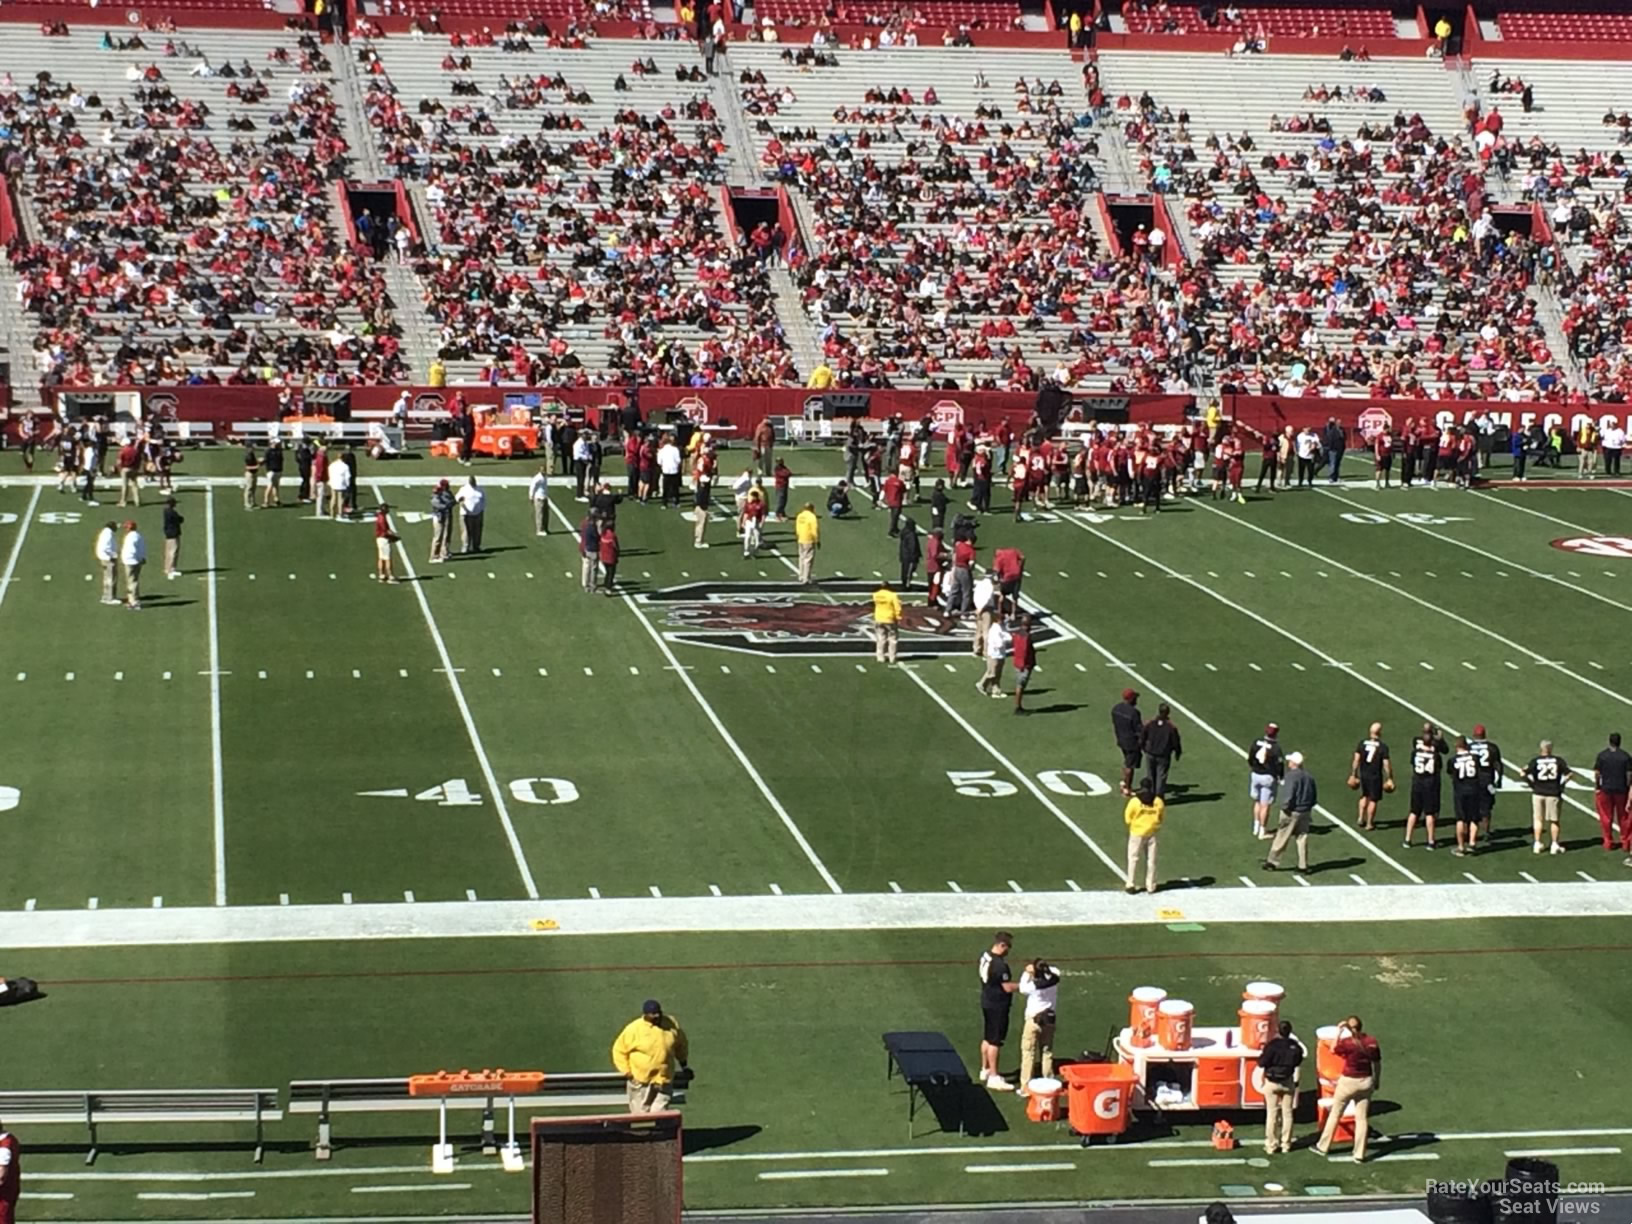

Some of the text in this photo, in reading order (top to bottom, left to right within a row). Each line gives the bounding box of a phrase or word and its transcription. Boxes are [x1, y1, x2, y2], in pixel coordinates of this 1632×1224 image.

[1364, 745, 1377, 763] 7
[1414, 756, 1435, 774] 54
[1453, 760, 1476, 779] 76
[1536, 763, 1558, 781] 23
[414, 777, 580, 806] 40
[945, 769, 1113, 797] 50
[1143, 1007, 1155, 1020] G
[1175, 1021, 1187, 1033] G
[1256, 1020, 1270, 1033] G
[1093, 1087, 1122, 1120] G
